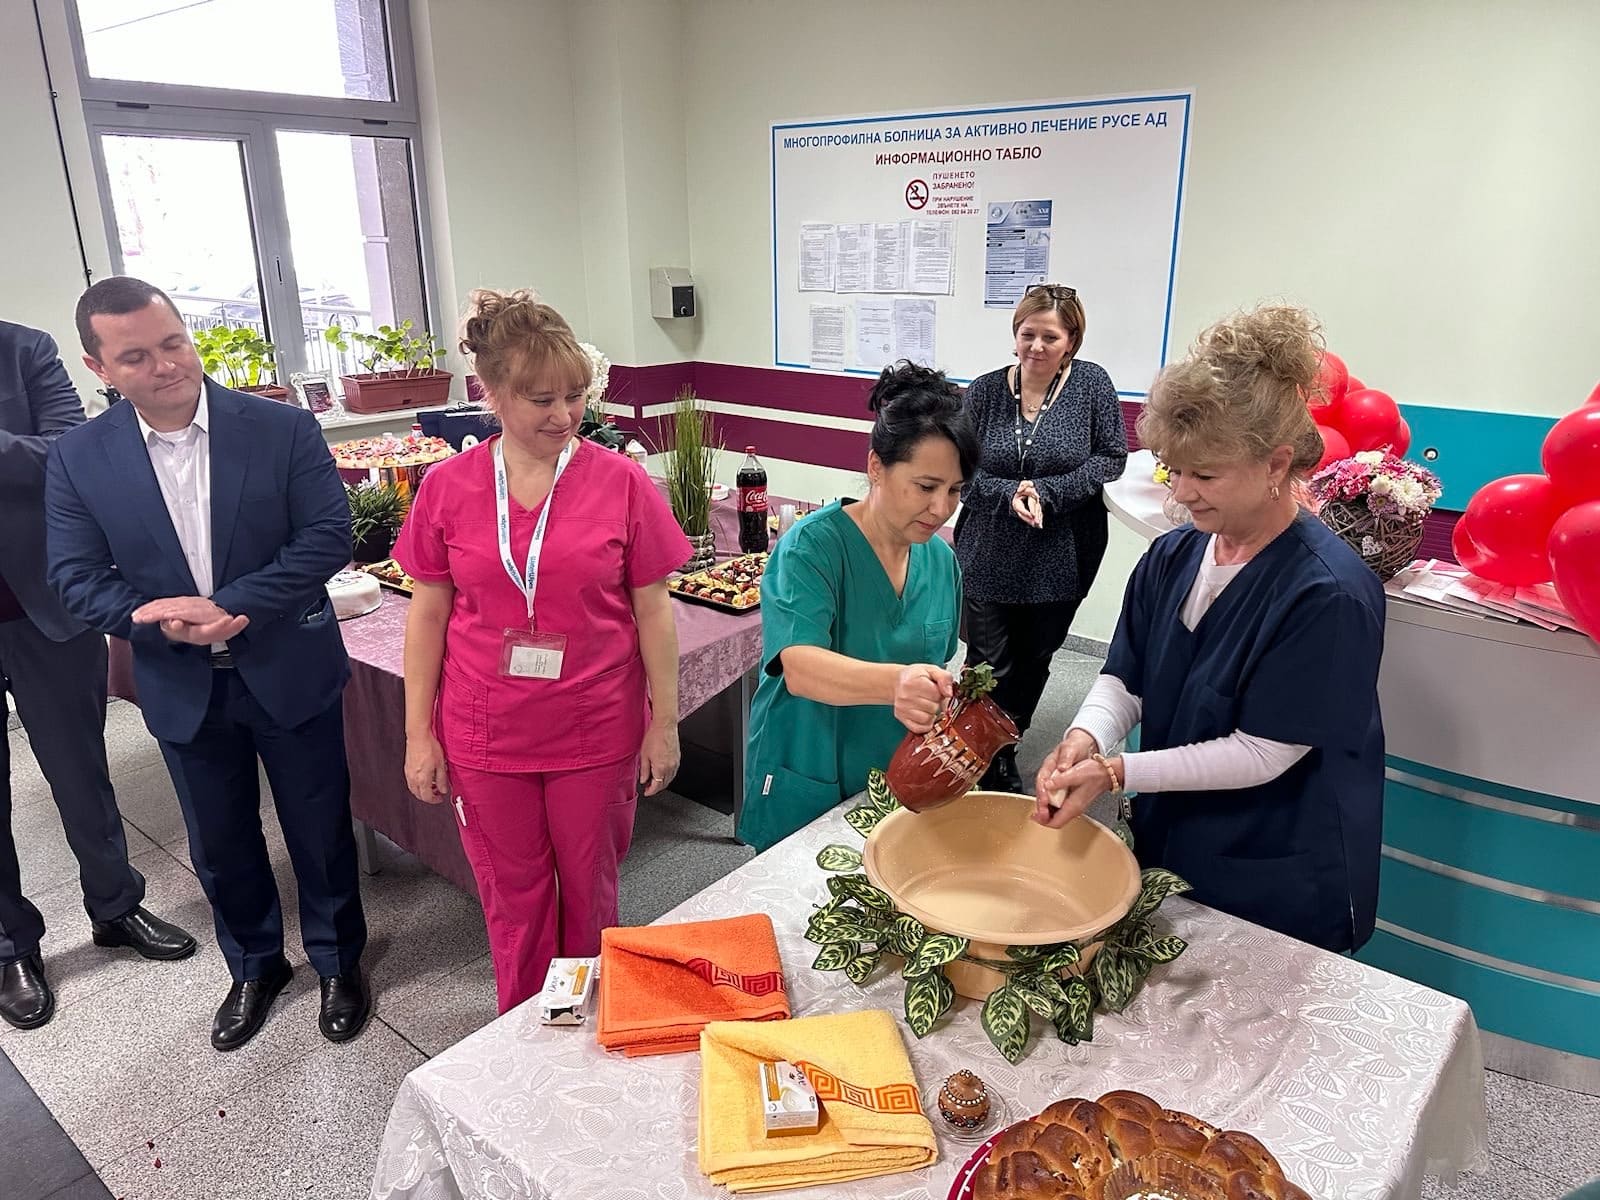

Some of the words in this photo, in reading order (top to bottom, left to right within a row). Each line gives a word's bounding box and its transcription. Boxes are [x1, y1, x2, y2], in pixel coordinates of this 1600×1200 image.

[783, 132, 882, 149] МНОГОПРОФИЛНА
[884, 128, 942, 143] БОЛНИЦА
[945, 127, 961, 139] ЗА
[964, 122, 1027, 137] АКТИВНО
[1030, 116, 1098, 133] ЛЕЧЕНИЕ
[1102, 113, 1141, 129] РУСЕ
[1144, 111, 1168, 127] АД
[875, 148, 992, 165] ИНФОРМАЦИОННО
[995, 146, 1042, 161] ТАБЛО
[932, 171, 976, 180] ПУШЕНЕТО
[932, 181, 975, 190] ЗАБРАНЕНО!
